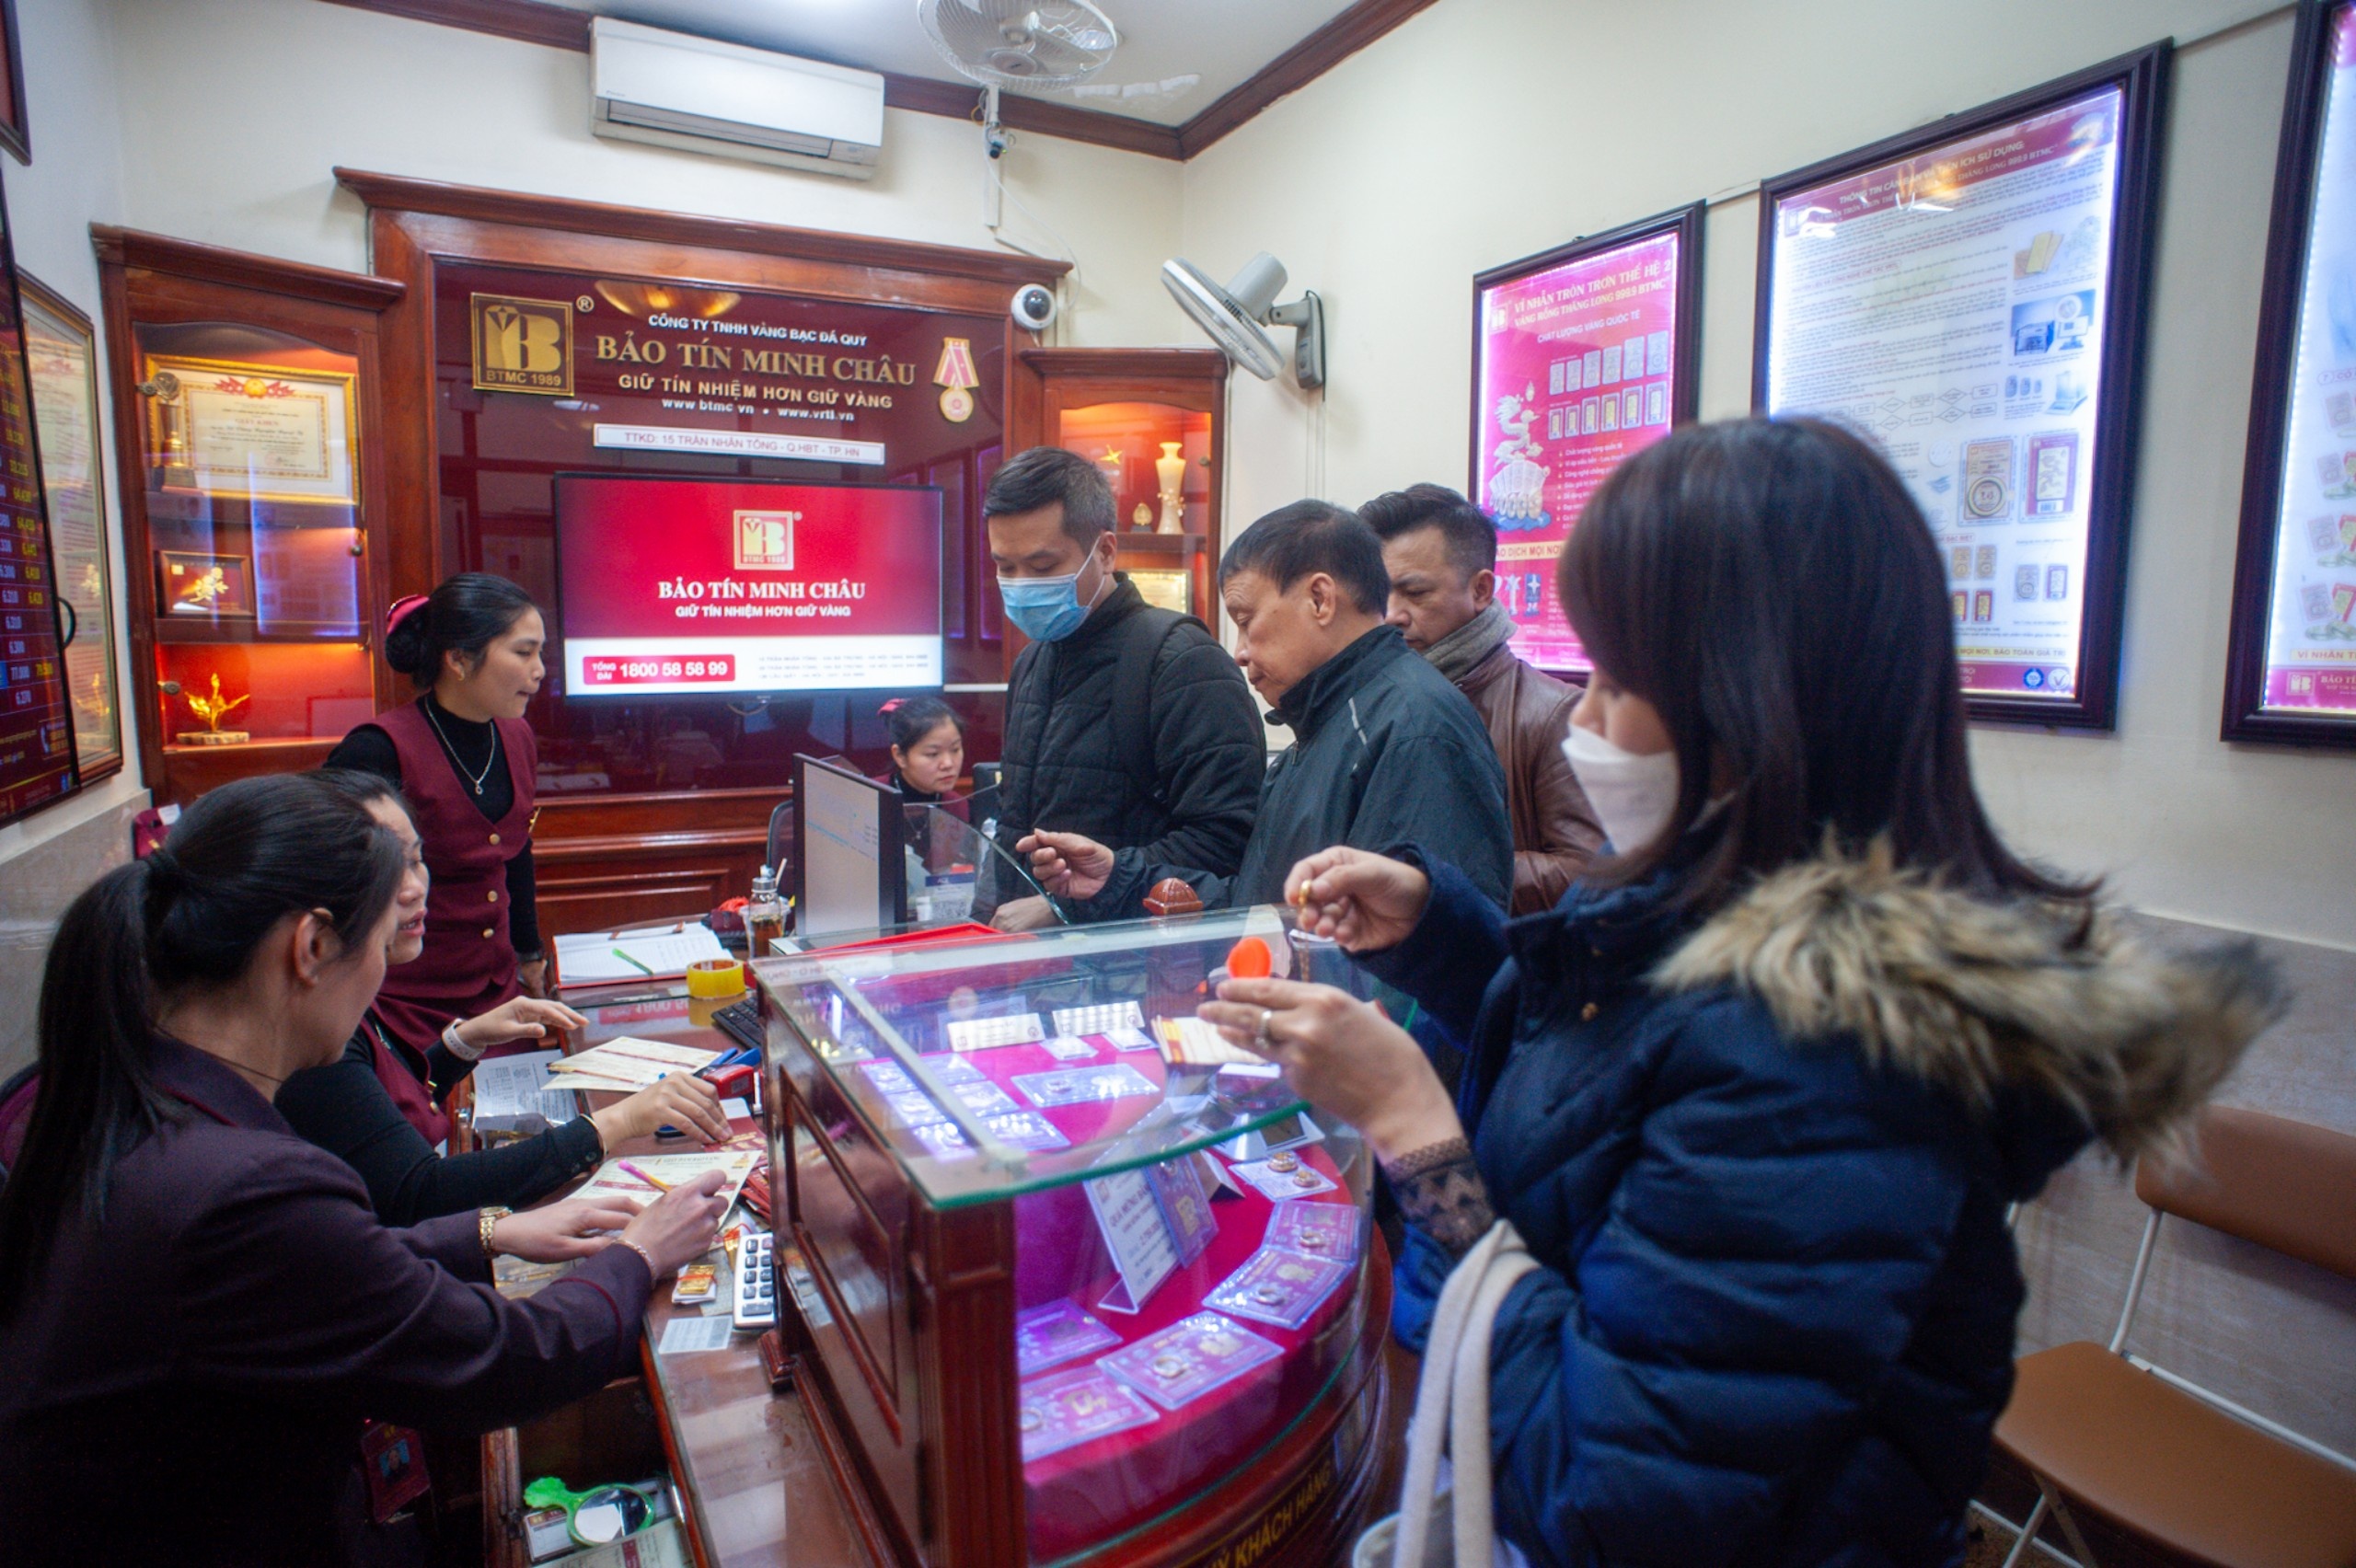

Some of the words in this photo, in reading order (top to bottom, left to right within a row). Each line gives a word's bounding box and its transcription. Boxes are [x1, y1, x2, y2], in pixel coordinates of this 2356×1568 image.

[1663, 259, 1672, 272] 2
[1637, 279, 1668, 294] BTMC
[649, 312, 689, 329] CÔNG
[691, 318, 709, 331] TY
[711, 321, 748, 336] TNHH
[751, 321, 788, 340] VÀNG
[790, 329, 817, 344] BẠC
[819, 329, 838, 344] ĐÁ
[595, 330, 666, 364] BẢO
[677, 338, 733, 370] TÍN
[741, 348, 827, 378] MINH
[832, 354, 917, 386] CHÂU
[486, 370, 527, 384] BTMC
[530, 374, 562, 386] 1989
[618, 373, 654, 391] GIỮ
[661, 375, 691, 394] TÍN
[698, 379, 757, 401] NHIỆM
[762, 386, 803, 402] HƠN
[807, 387, 839, 405] GIỮ
[844, 390, 894, 409] VÀNG
[662, 434, 676, 445] 15
[845, 447, 860, 457] HN
[658, 577, 704, 599] BẢO
[708, 578, 745, 599] TÍN
[749, 582, 805, 599] MINH
[809, 579, 866, 599] CHÂU
[676, 605, 700, 617] GIỮ
[701, 604, 722, 617] TÍN
[723, 605, 763, 619] NHIỆM
[765, 605, 794, 617] HƠN
[795, 604, 817, 617] GIỮ
[819, 604, 851, 617] VÀNG
[619, 663, 658, 678] 1800
[661, 662, 683, 677] 58
[685, 662, 706, 676] 58
[708, 661, 728, 676] 99
[1235, 1501, 1293, 1568] KHÁCH
[1297, 1459, 1331, 1519] HÀNG
